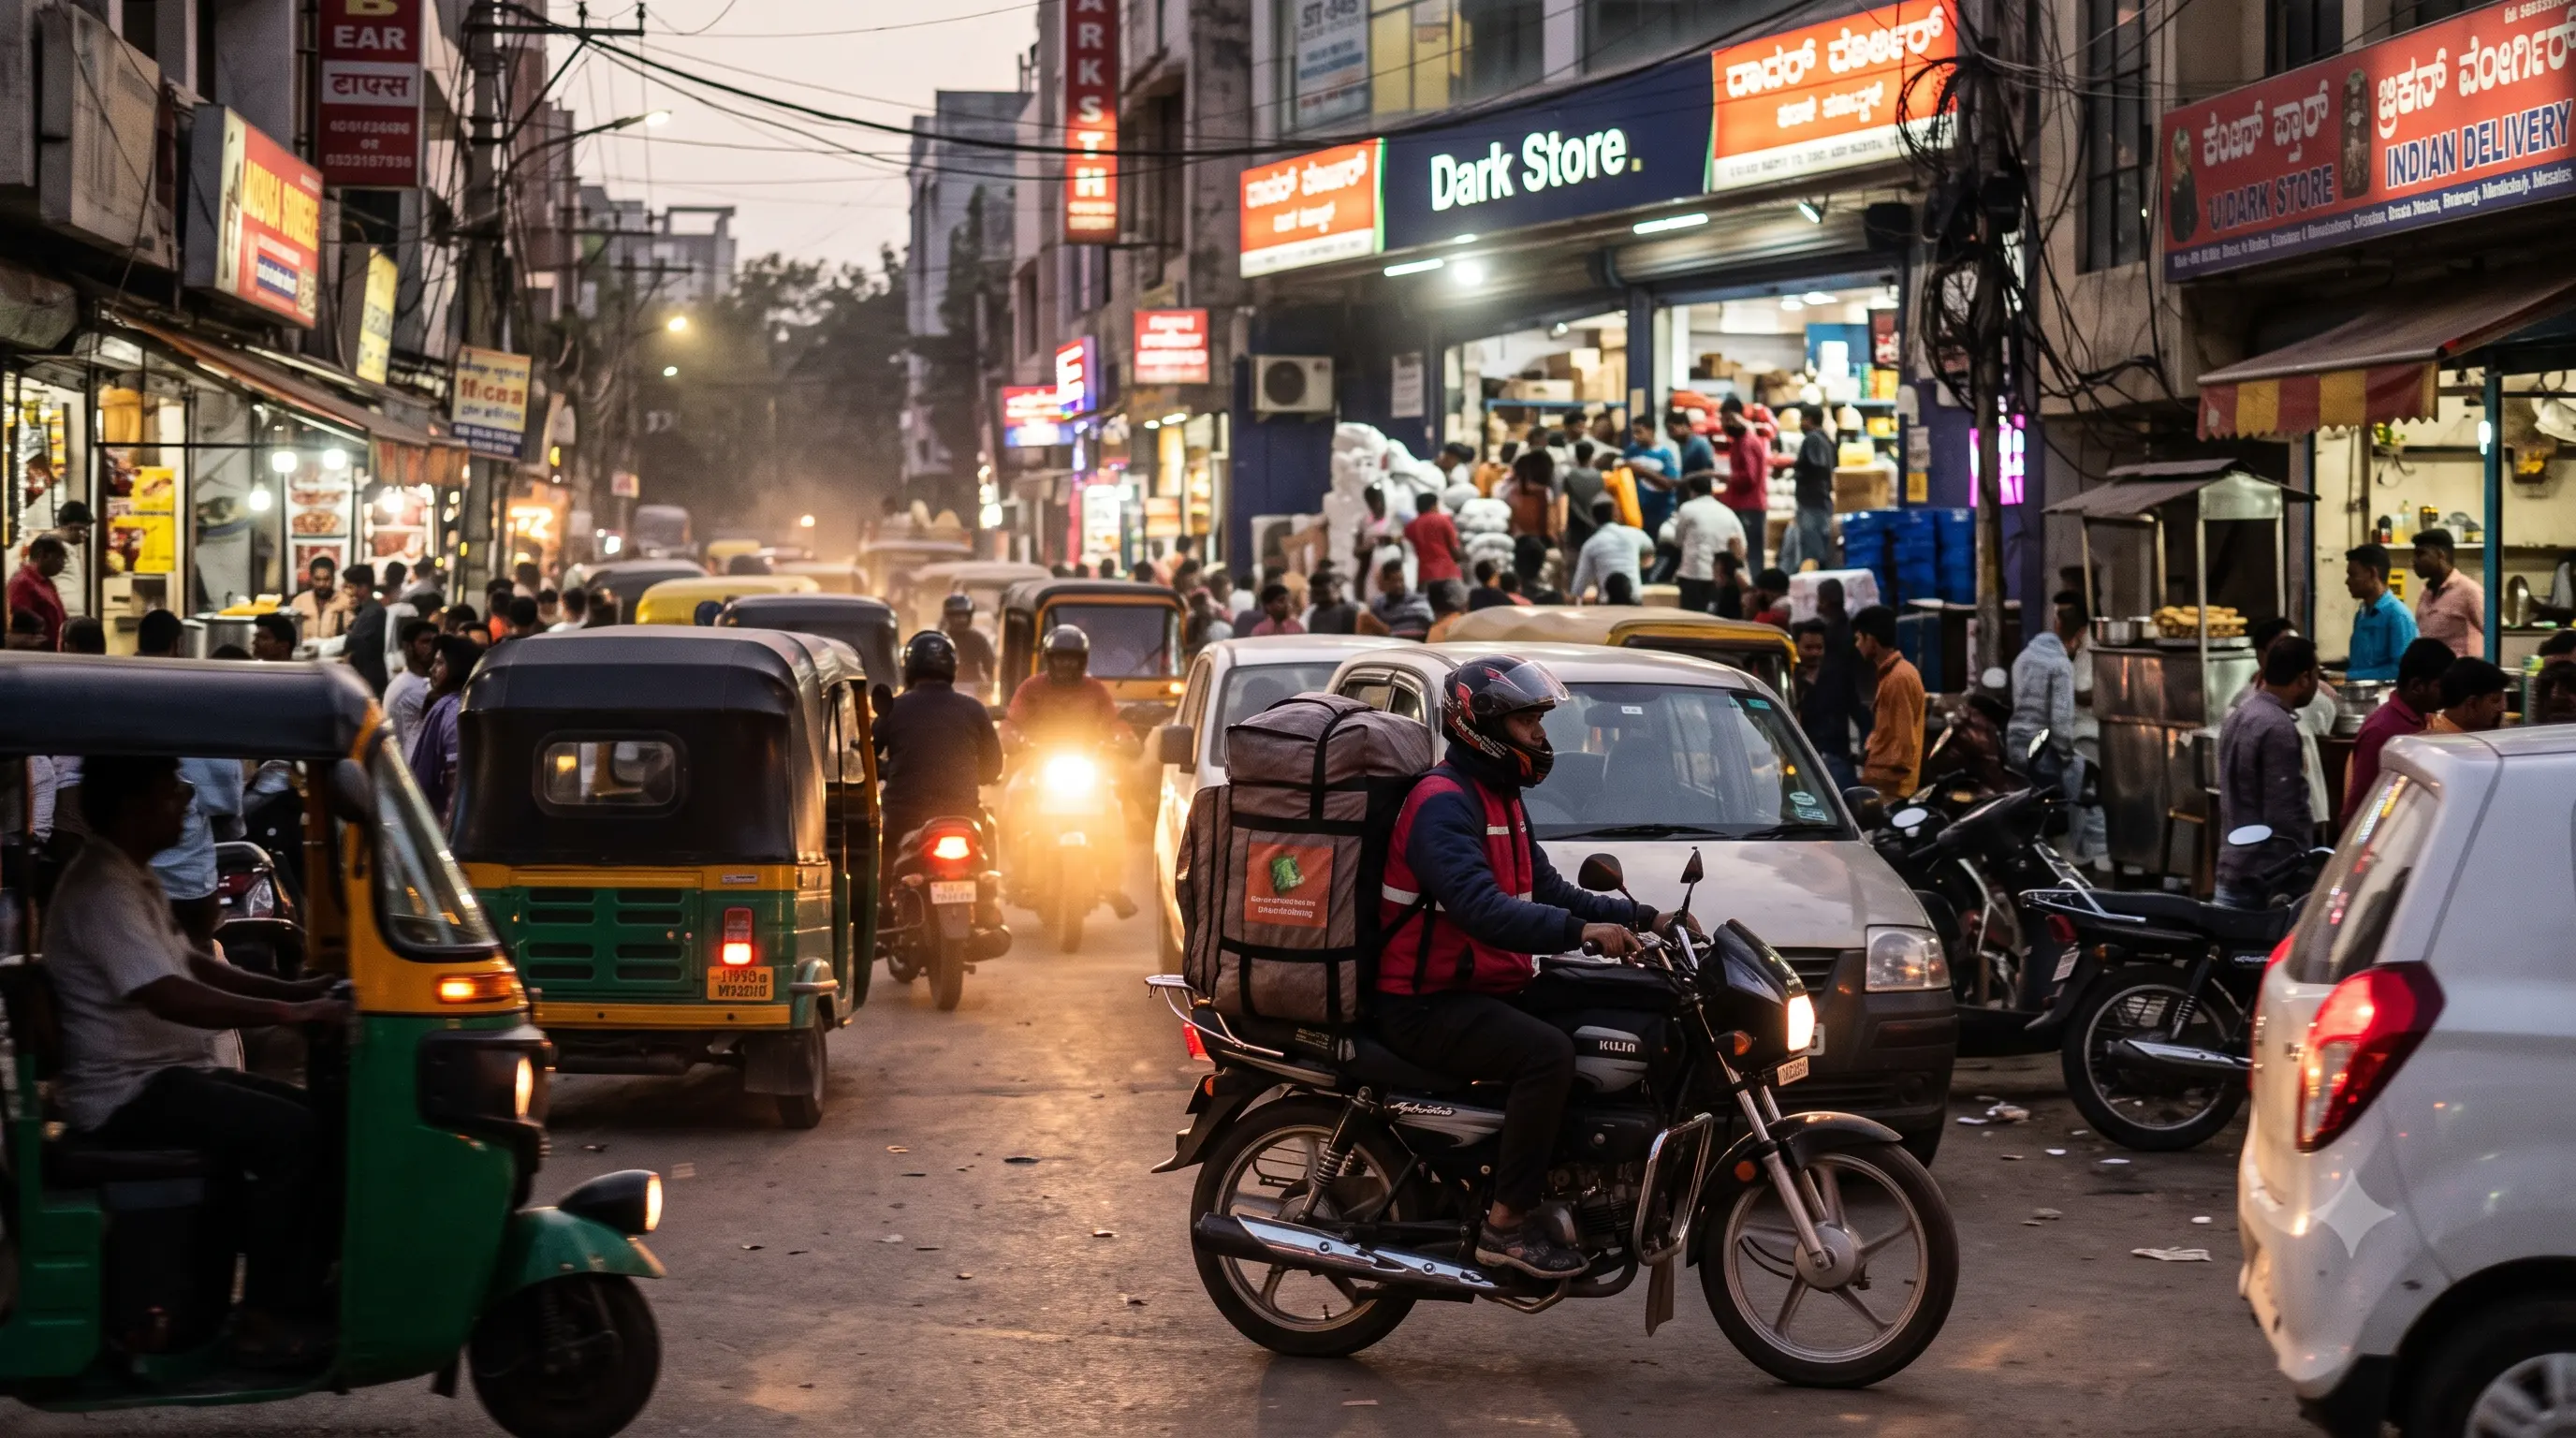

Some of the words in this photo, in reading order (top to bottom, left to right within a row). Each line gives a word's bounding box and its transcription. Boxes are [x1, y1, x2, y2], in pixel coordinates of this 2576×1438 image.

[333, 25, 407, 51] EAR
[2386, 128, 2457, 190] INDIAN
[2462, 98, 2573, 171] DELIVERY
[1431, 141, 1516, 212] Dark
[2276, 163, 2334, 217] STORE
